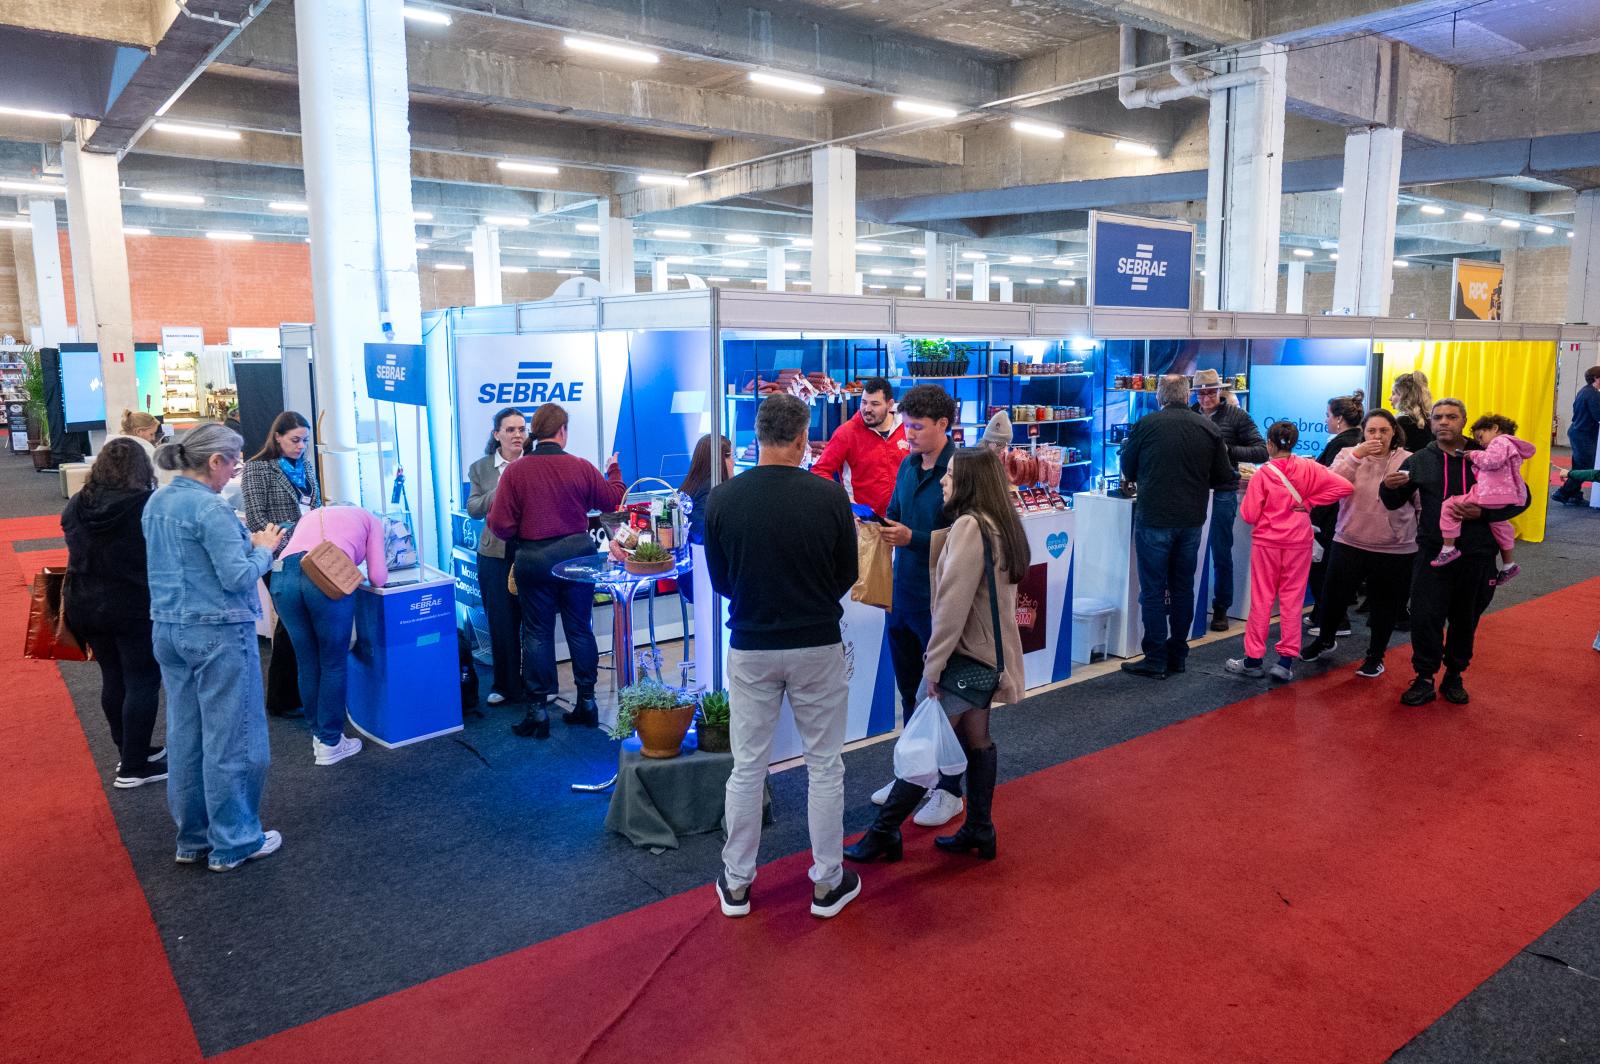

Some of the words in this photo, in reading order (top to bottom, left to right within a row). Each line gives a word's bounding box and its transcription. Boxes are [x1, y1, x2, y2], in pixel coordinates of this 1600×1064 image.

[1117, 257, 1168, 277] SEBRAE
[1469, 281, 1489, 301] RPC
[376, 364, 406, 381] SEBRAE
[478, 382, 584, 403] SEBRAE
[410, 598, 443, 611] SEBRAE
